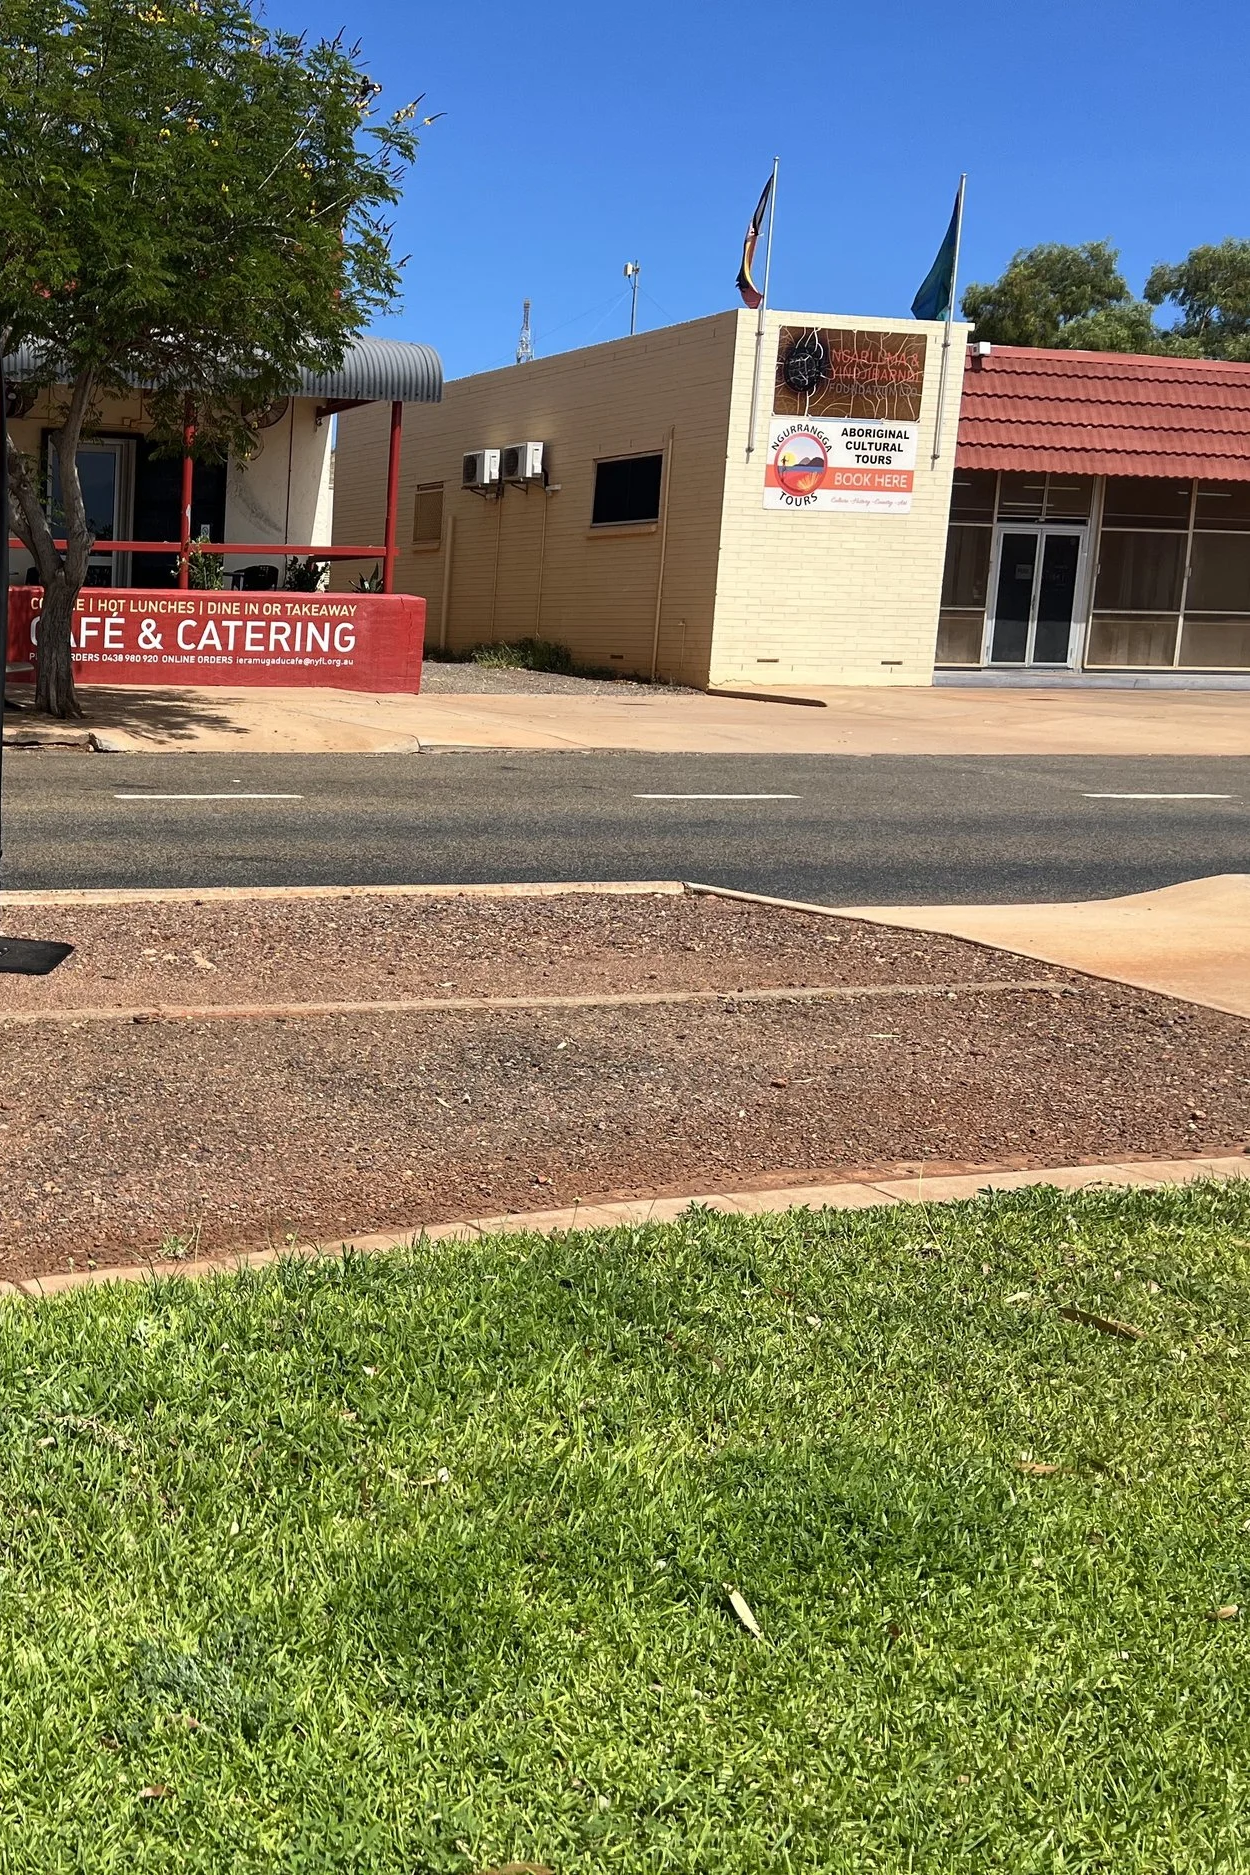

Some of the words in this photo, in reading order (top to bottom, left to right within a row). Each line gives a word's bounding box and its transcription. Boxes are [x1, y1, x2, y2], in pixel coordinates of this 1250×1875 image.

[910, 353, 920, 367] &
[829, 383, 895, 396] FOUNDATION
[771, 423, 833, 453] NGURRANGGA
[841, 427, 910, 440] ABORIGINAL
[845, 441, 904, 453] CULTURAL
[855, 454, 892, 465] TOURS
[834, 472, 871, 486] BOOK
[874, 474, 908, 488] HERE
[779, 491, 818, 507] TOURS
[98, 599, 125, 612] HOT
[129, 600, 195, 614] LUNCHES
[207, 602, 240, 615] DINE
[244, 603, 259, 616] IN
[262, 603, 282, 616] OR
[285, 603, 357, 617] TAKEAWAY
[137, 618, 164, 650] &
[177, 619, 356, 653] CATERING
[70, 653, 100, 663] RDERS
[101, 654, 123, 663] 0438
[124, 654, 141, 663] 980
[142, 654, 159, 663] 920
[162, 655, 196, 664] ONLINE
[197, 655, 234, 665] ORDERS
